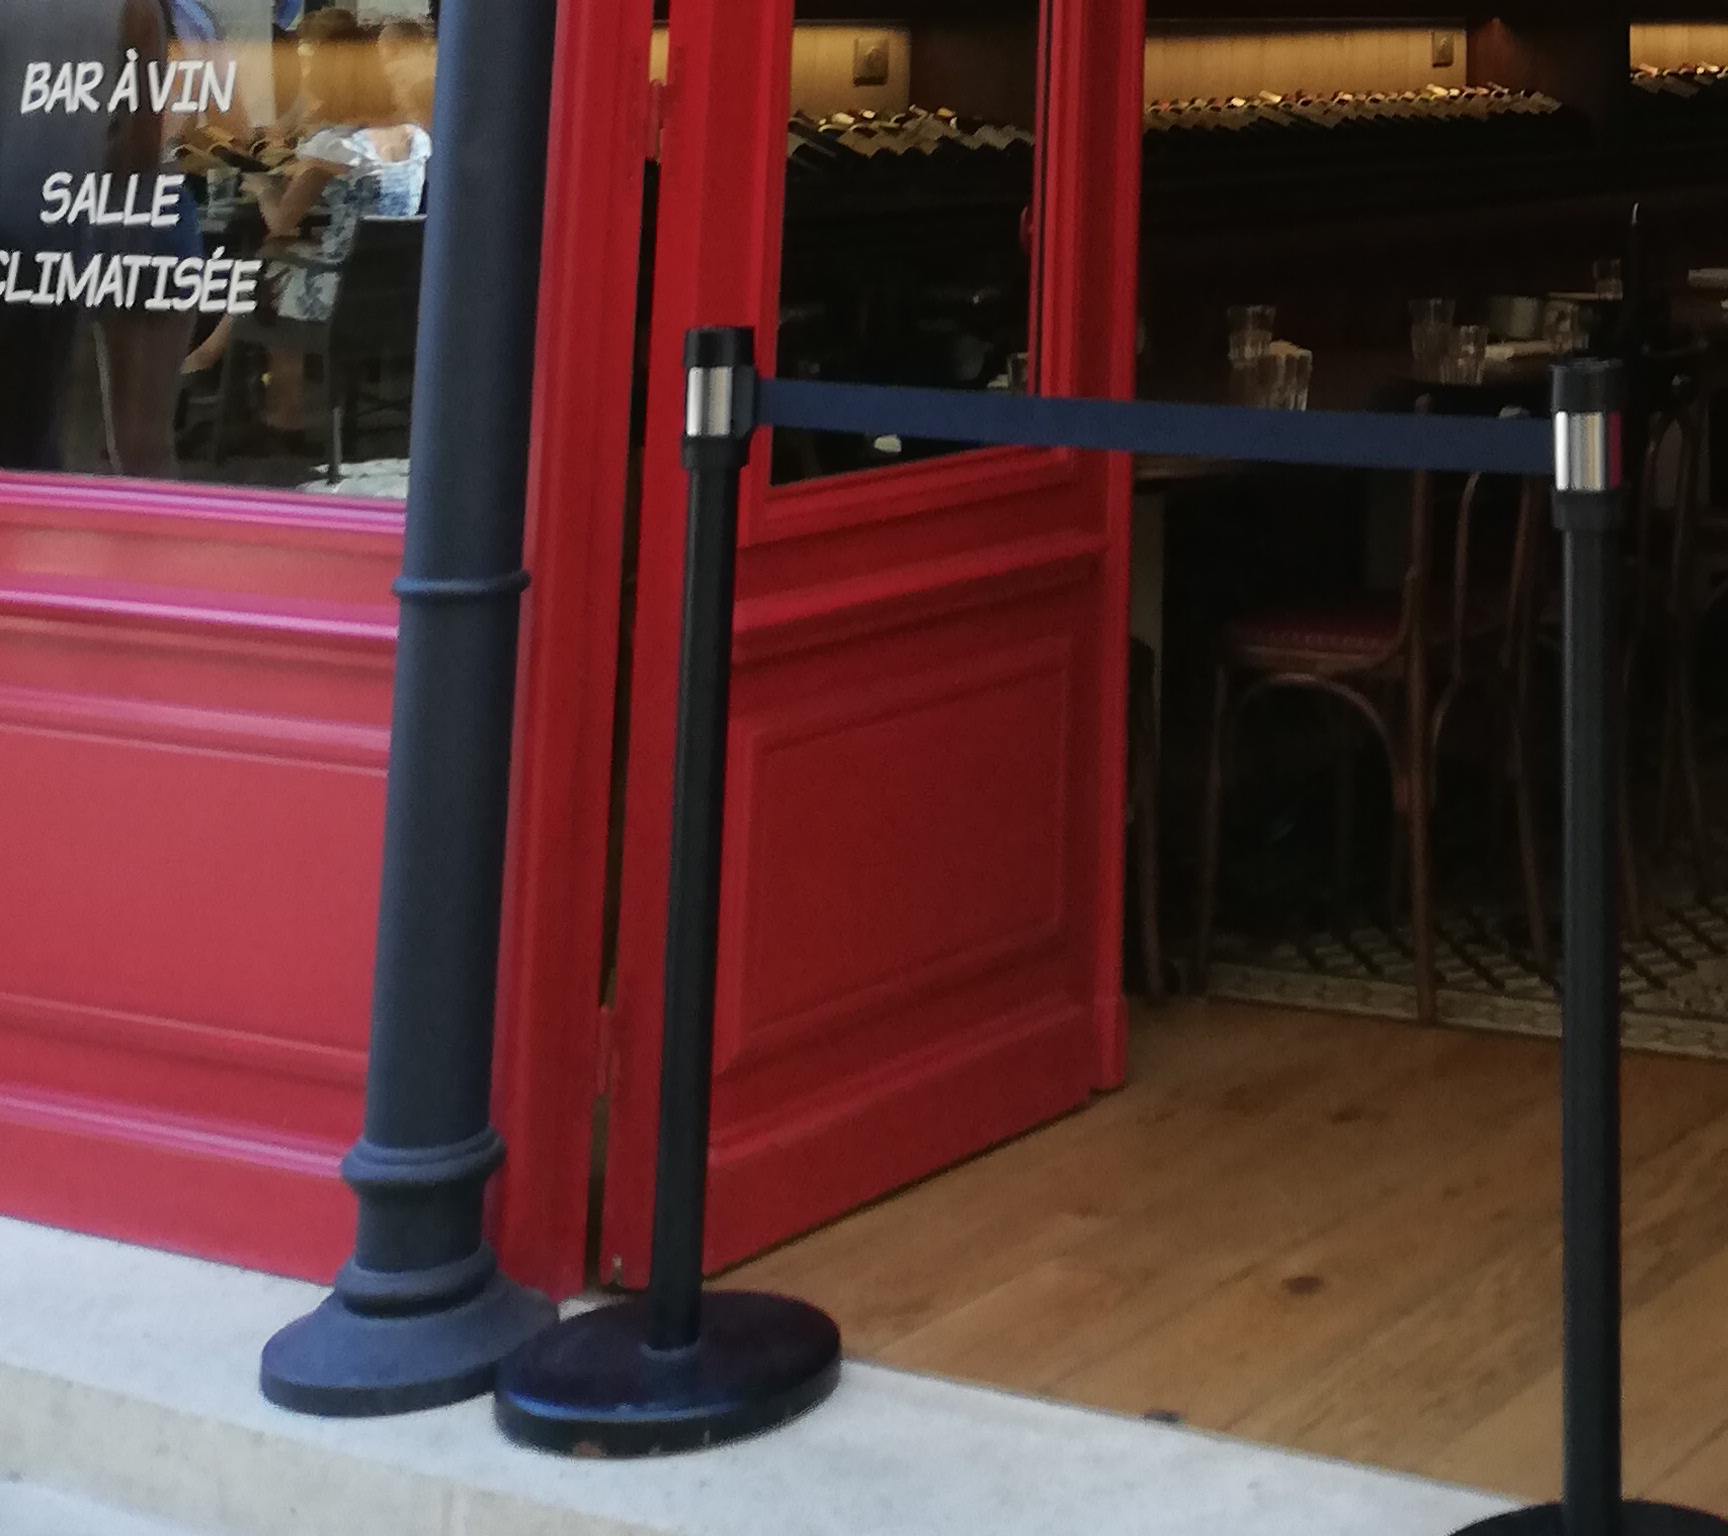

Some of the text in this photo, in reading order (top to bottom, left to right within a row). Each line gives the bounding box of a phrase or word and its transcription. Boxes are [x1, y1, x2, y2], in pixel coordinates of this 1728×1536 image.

[20, 47, 238, 114] BAR À VIN
[39, 170, 186, 228] SALLE
